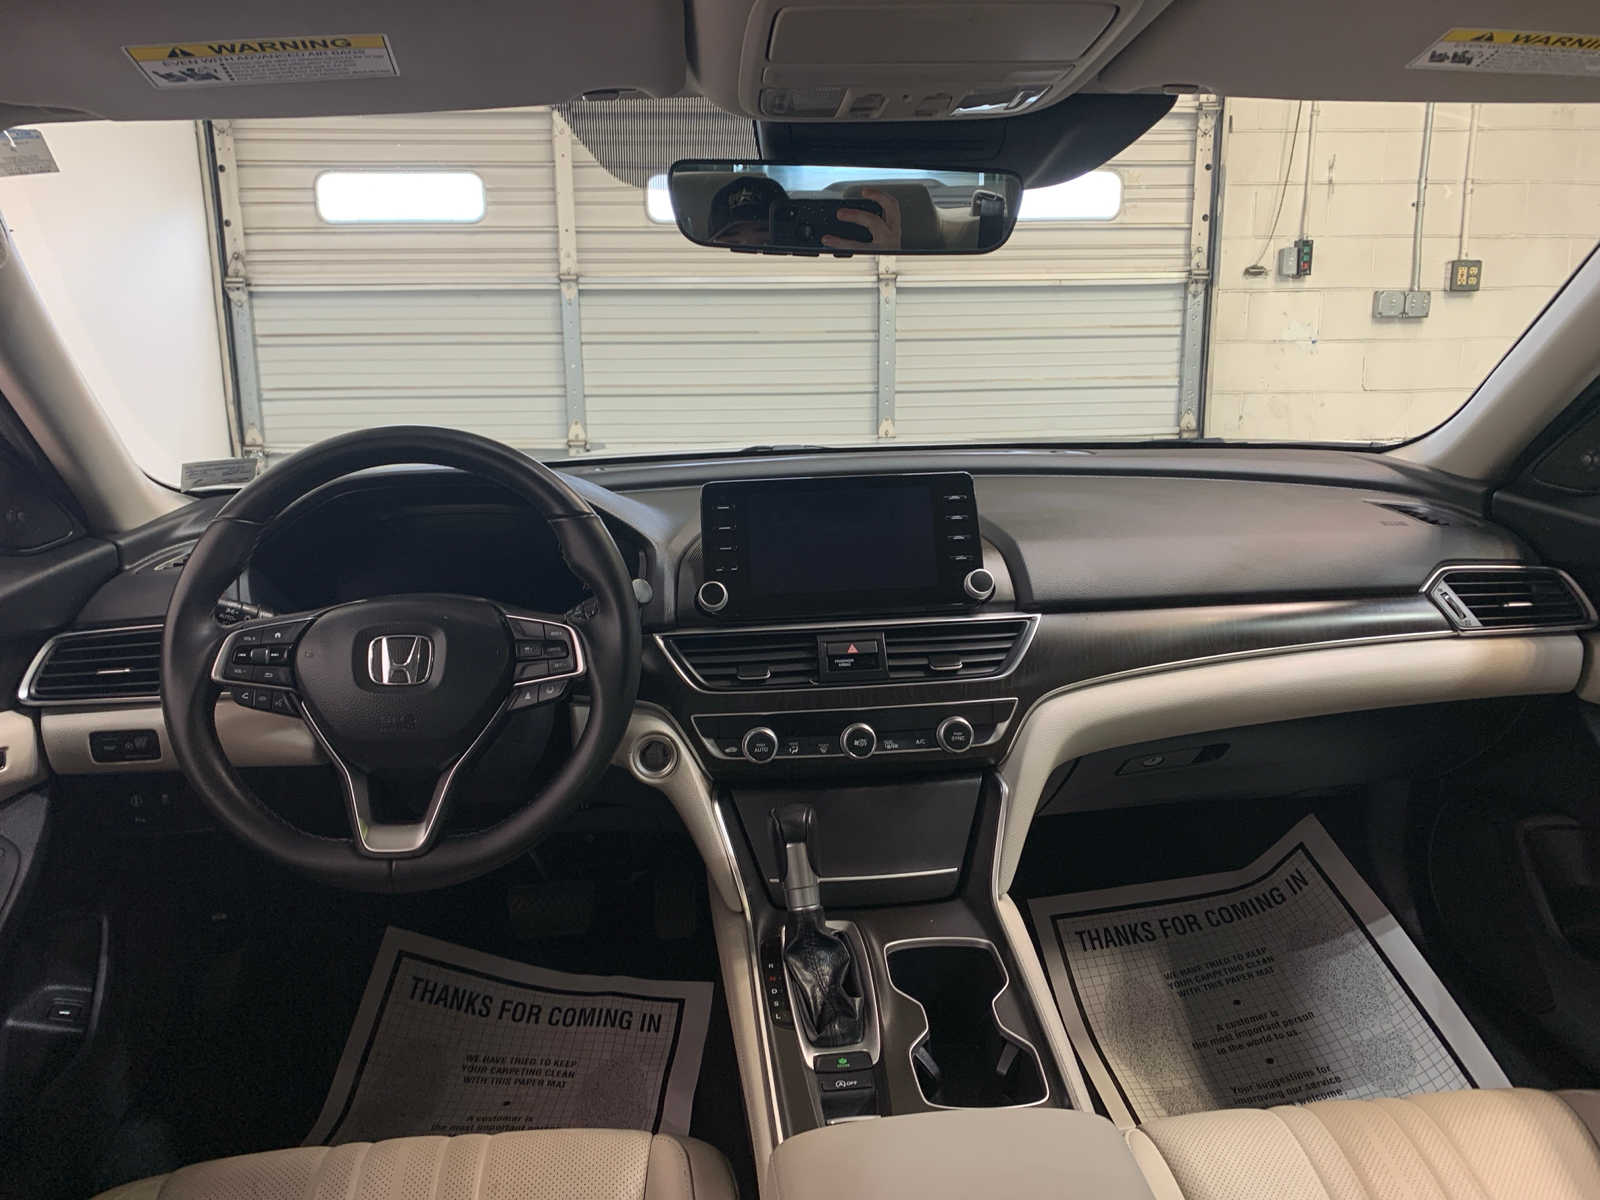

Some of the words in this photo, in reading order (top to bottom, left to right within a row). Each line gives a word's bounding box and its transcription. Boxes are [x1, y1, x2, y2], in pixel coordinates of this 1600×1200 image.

[208, 38, 353, 55] WARNING
[1075, 921, 1158, 952] THANKS
[1158, 914, 1203, 939] FOR
[1206, 886, 1286, 928] COMING
[1285, 867, 1309, 896] IN
[1232, 953, 1244, 962] TO
[1194, 964, 1246, 985] CARPETING
[408, 976, 492, 1018] THANKS
[498, 1000, 542, 1025] FOR
[548, 1006, 633, 1031] COMING
[639, 1013, 662, 1033] IN
[1192, 1039, 1209, 1049] the
[1210, 1033, 1234, 1046] most
[1235, 1021, 1281, 1039] important
[1282, 1011, 1314, 1028] person
[1217, 1024, 1225, 1032] A
[1224, 1013, 1268, 1030] customer
[1270, 1009, 1279, 1017] is
[1228, 1043, 1244, 1052] the
[1246, 1033, 1273, 1047] world
[1274, 1032, 1284, 1040] to
[1286, 1028, 1302, 1038] us.
[462, 1064, 487, 1073] YOUR
[490, 1066, 541, 1076] CARPETING
[544, 1069, 576, 1079] CLEAN
[483, 1055, 506, 1064] HAVE
[510, 1056, 537, 1066] TRIED
[540, 1058, 551, 1066] TO
[553, 1058, 578, 1068] KEEP
[463, 1076, 487, 1085] WITH
[490, 1077, 511, 1086] THIS
[514, 1078, 544, 1088] PAPER
[546, 1080, 568, 1089] MAT
[1231, 1085, 1253, 1096] Your
[1255, 1069, 1315, 1090] suggestions
[1316, 1065, 1331, 1075] for
[1233, 1091, 1286, 1105] improving
[1286, 1086, 1303, 1096] our
[1304, 1076, 1342, 1090] service
